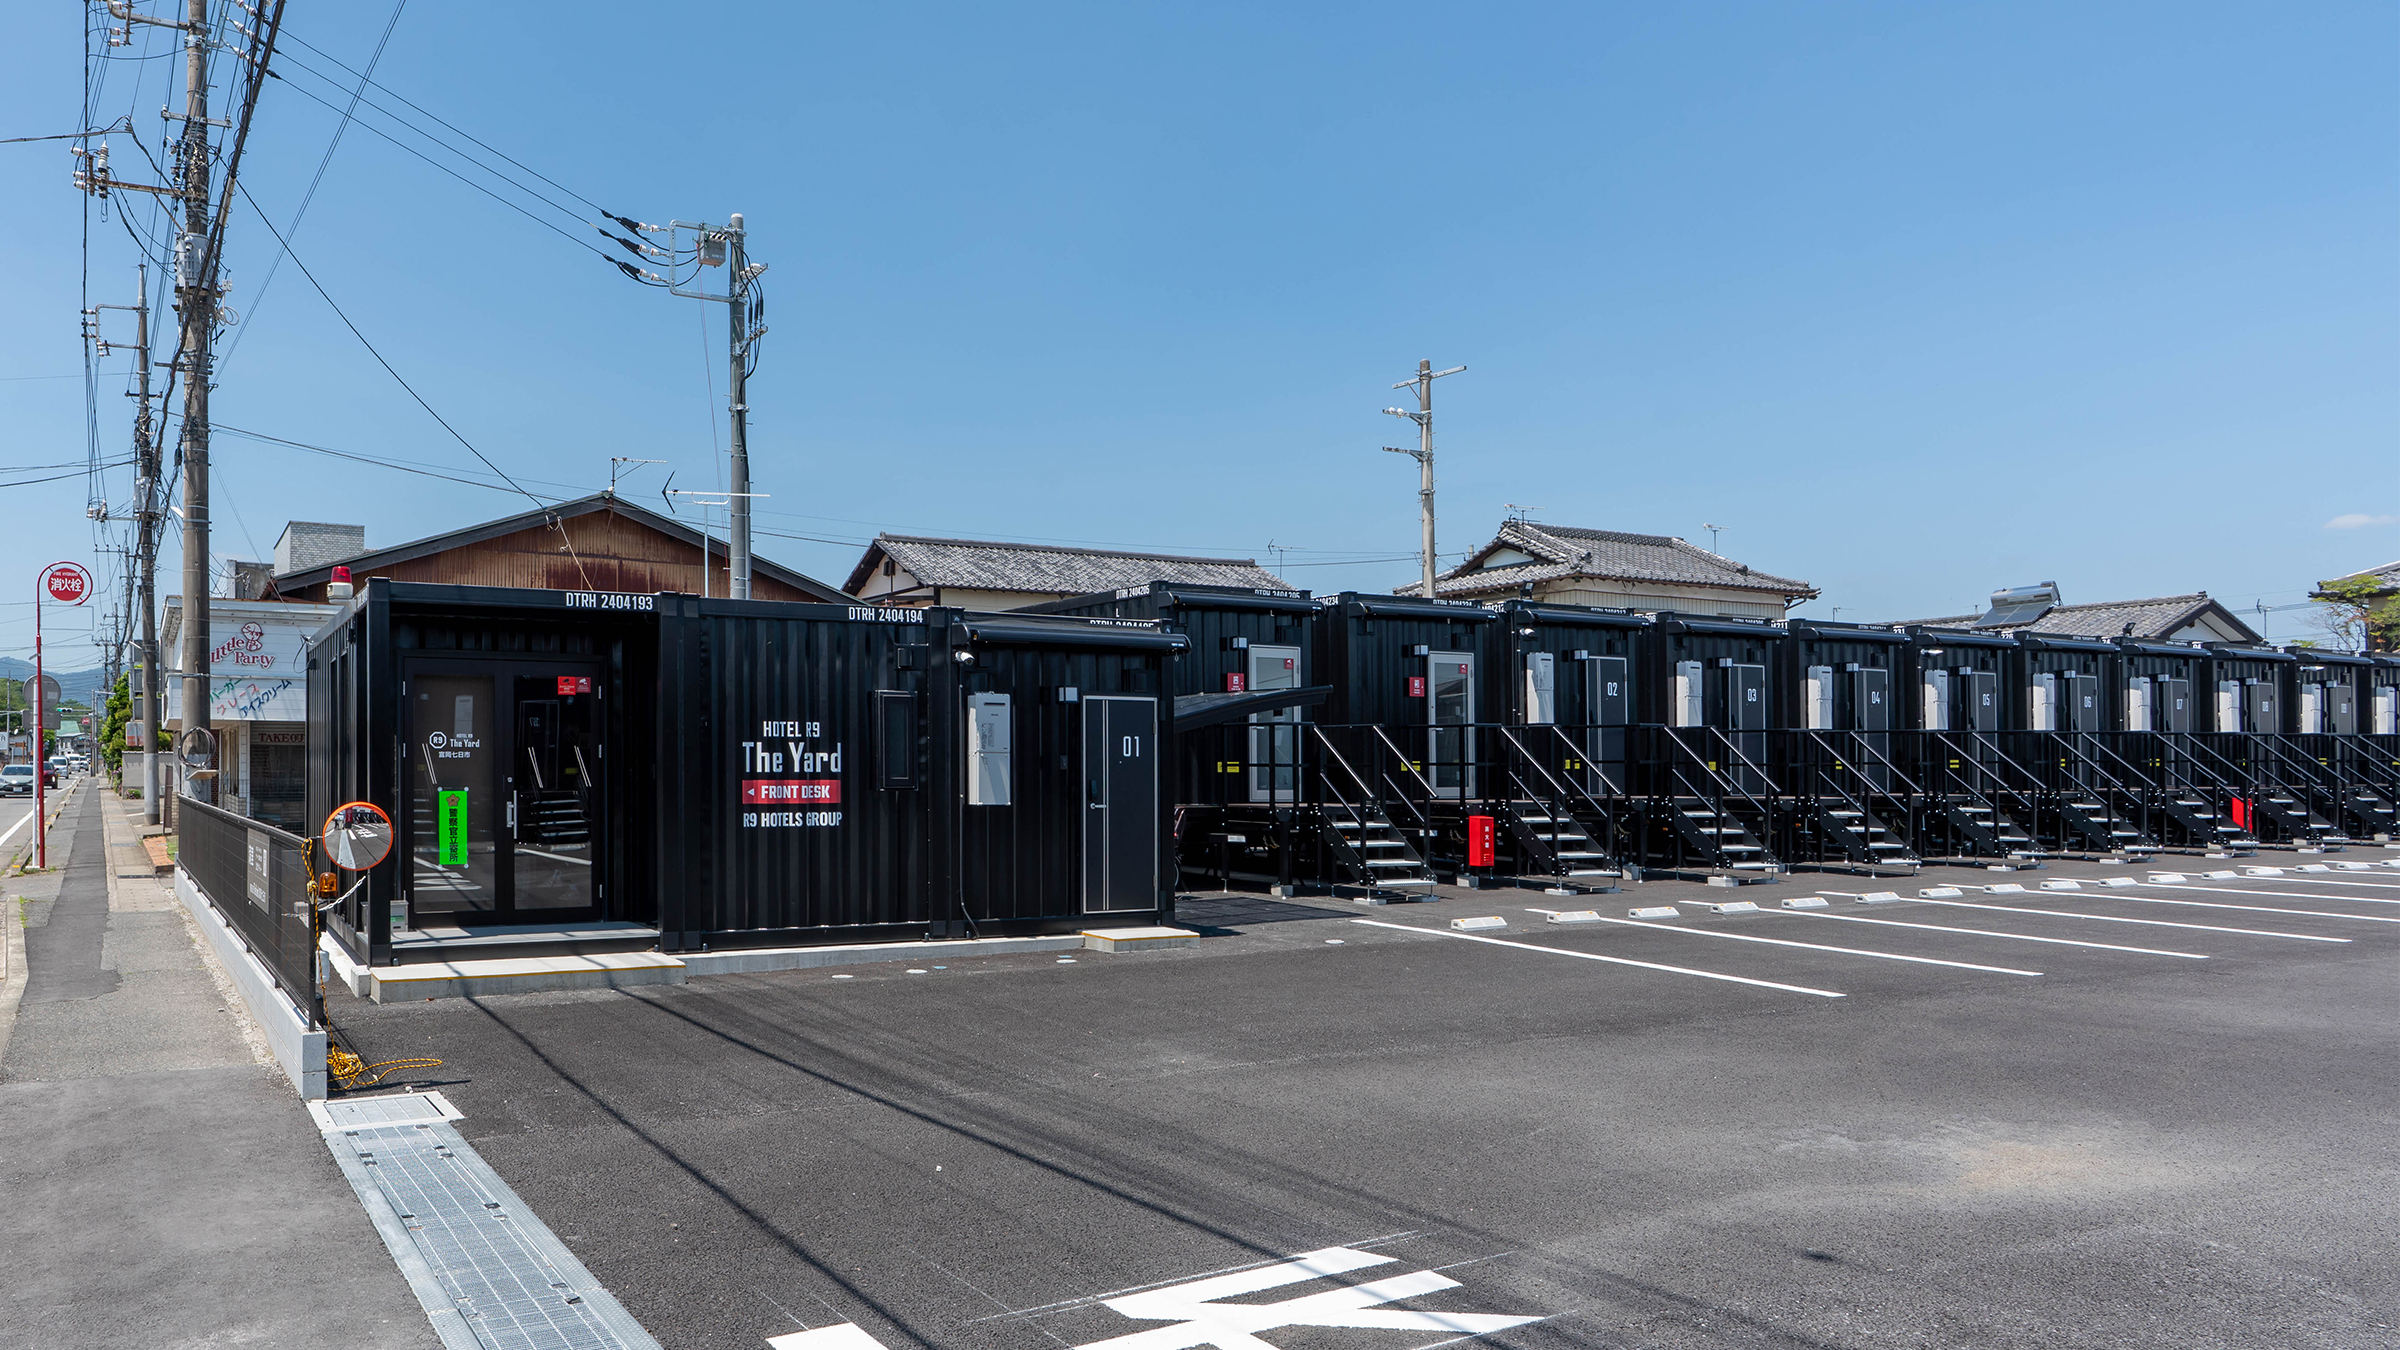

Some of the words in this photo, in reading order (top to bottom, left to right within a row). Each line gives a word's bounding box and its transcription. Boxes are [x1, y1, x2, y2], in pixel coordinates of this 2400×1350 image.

[50, 577, 82, 592] 消火栓
[566, 592, 597, 608] DTRH
[601, 594, 653, 611] 2404193
[848, 607, 875, 621] DTRH
[878, 608, 923, 623] 2404194
[211, 637, 245, 662] Little
[235, 652, 275, 668] Party
[1607, 681, 1618, 697] 02
[1747, 687, 1757, 702] 03
[240, 679, 293, 718] アイスクリーム
[1871, 691, 1881, 704] 04
[1982, 693, 1991, 706] 05
[763, 720, 802, 738] HOTEL
[806, 721, 820, 738] R9
[433, 736, 443, 744] R9
[450, 739, 463, 748] The
[464, 739, 480, 748] Yard
[1123, 736, 1140, 757] 01
[742, 741, 783, 773] The
[788, 741, 842, 773] Yard
[761, 785, 799, 799] FRONT
[801, 785, 830, 799] DESK
[743, 812, 758, 828] R9
[761, 812, 803, 828] HOTELS
[806, 811, 842, 827] GROUP
